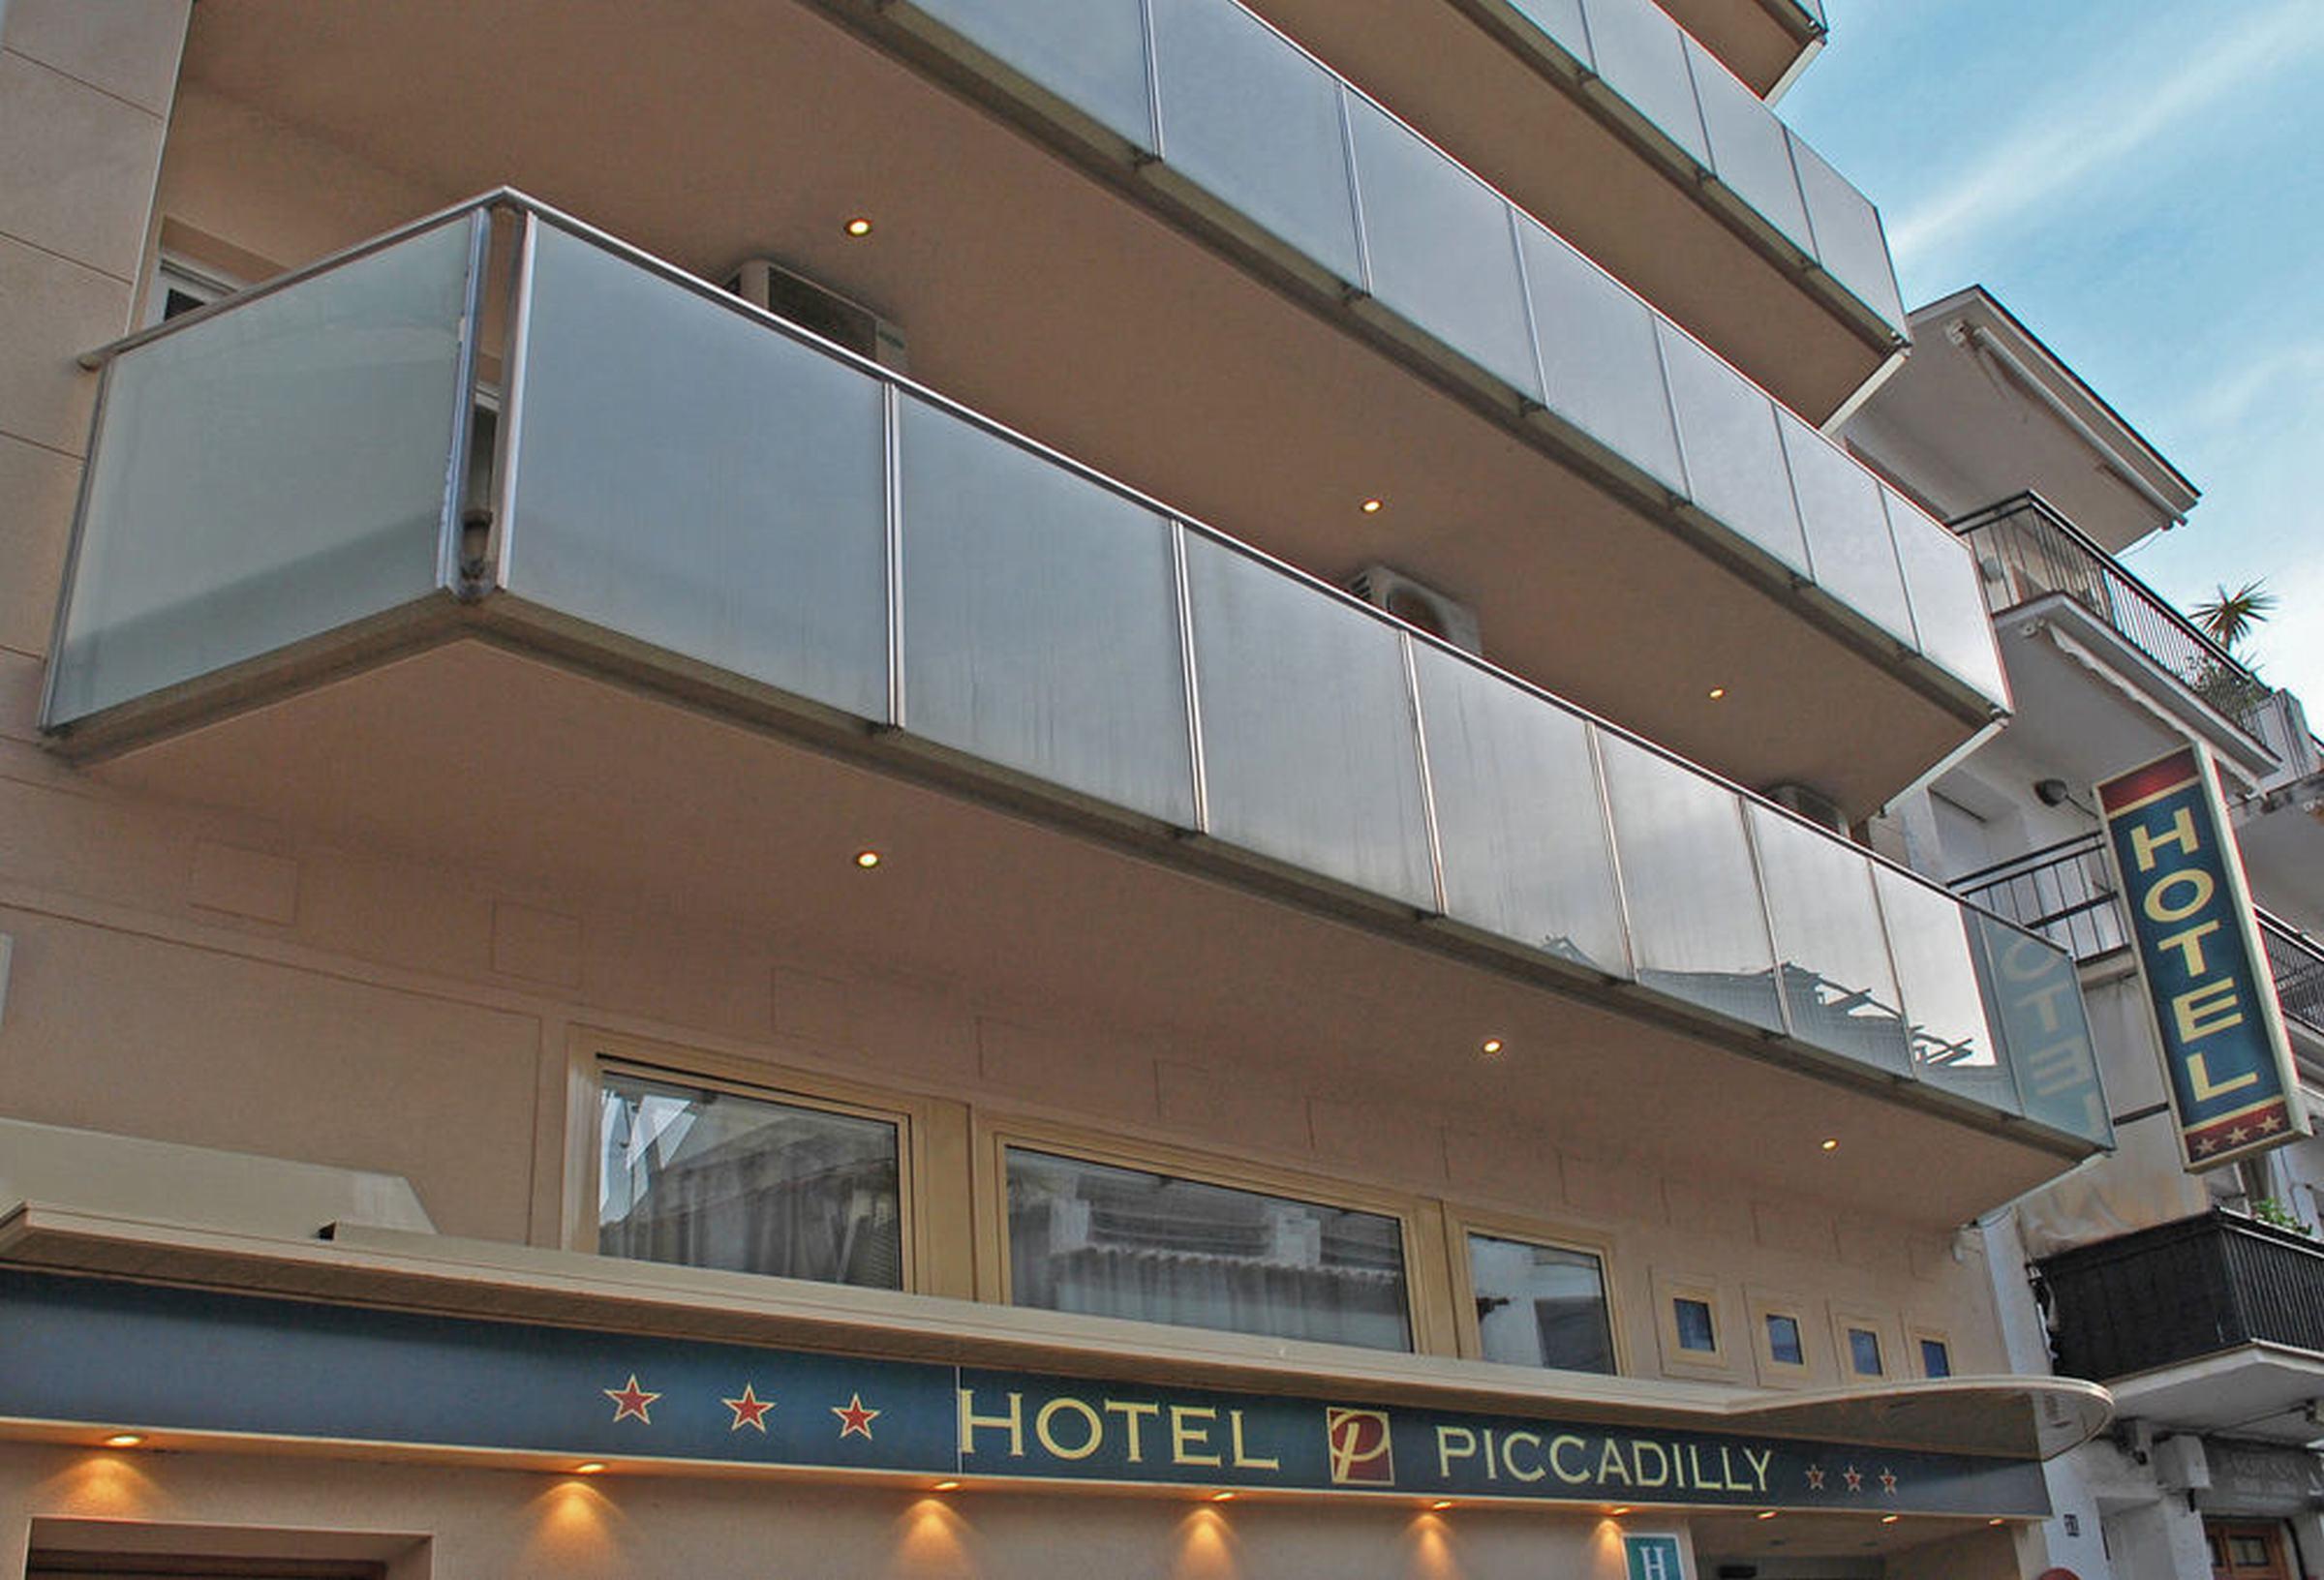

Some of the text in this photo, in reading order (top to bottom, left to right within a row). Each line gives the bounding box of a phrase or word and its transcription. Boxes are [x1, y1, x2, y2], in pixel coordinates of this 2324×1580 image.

[2130, 806, 2259, 1103] HOTEL
[958, 1388, 1279, 1471] HOTEL
[1435, 1425, 1773, 1493] PICCADILLY
[1638, 1546, 1669, 1580] H
